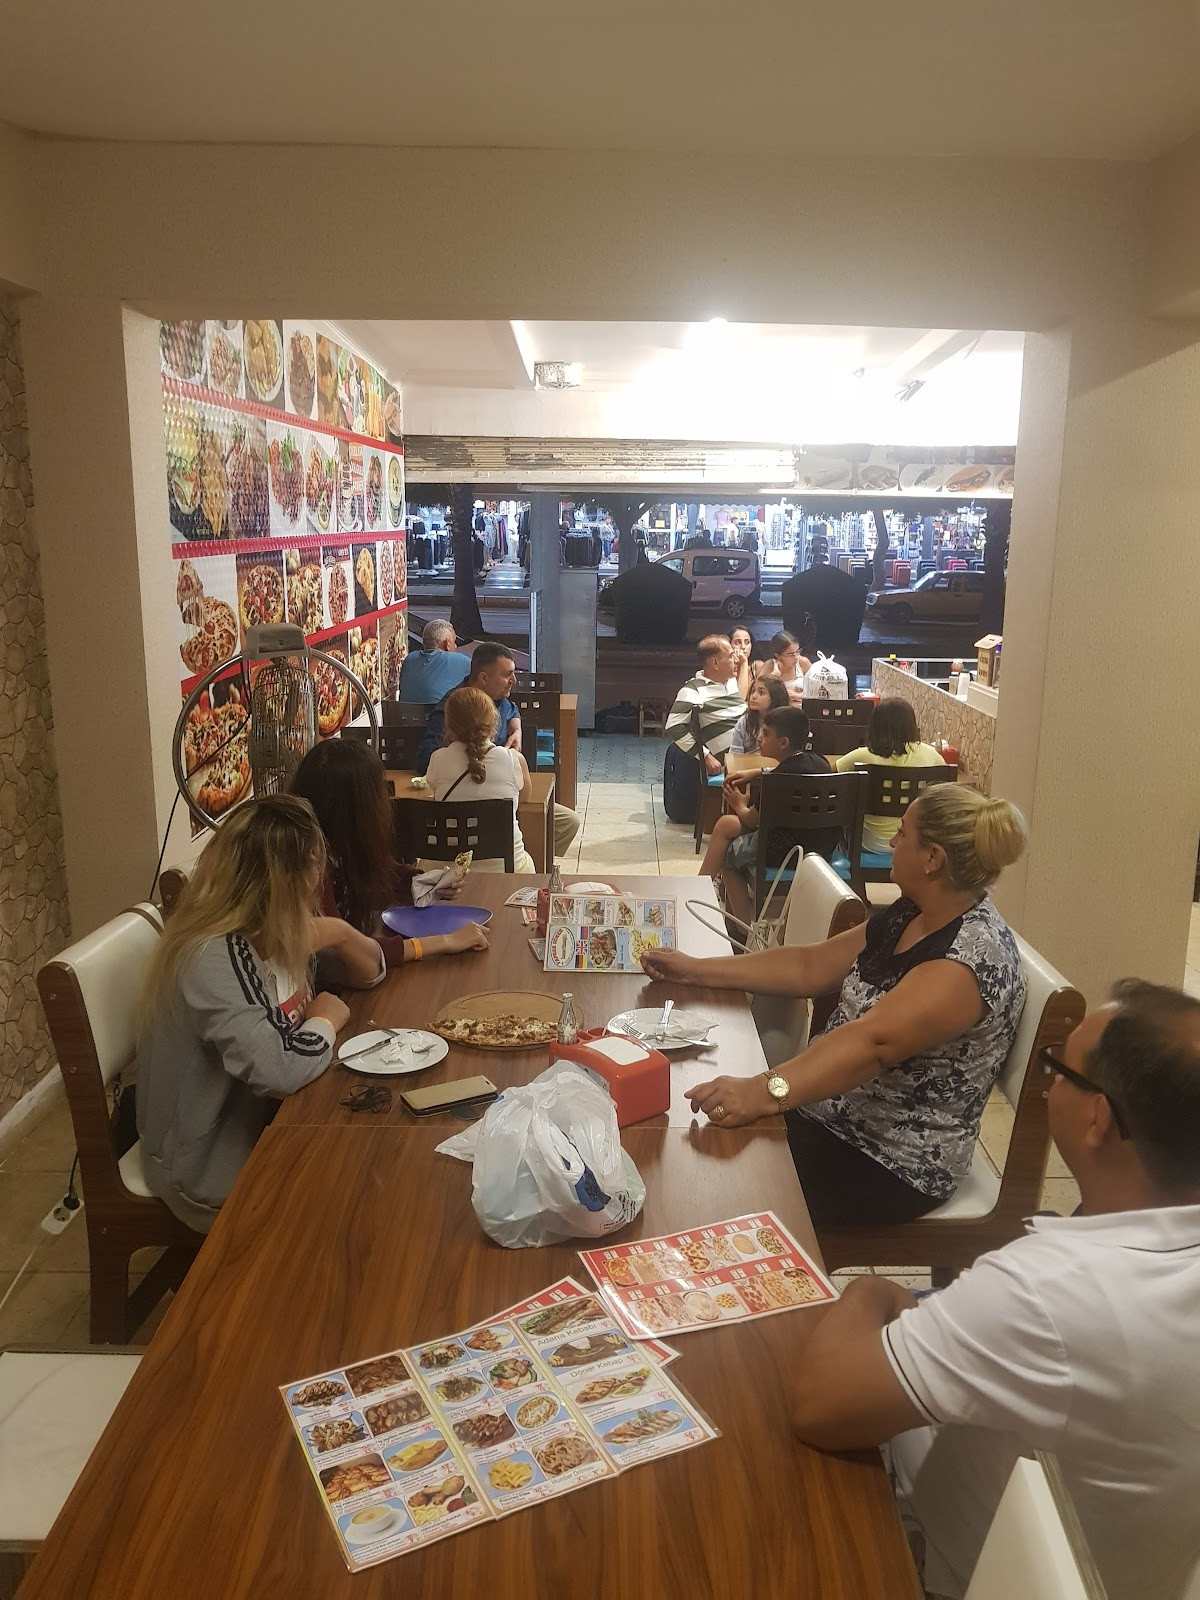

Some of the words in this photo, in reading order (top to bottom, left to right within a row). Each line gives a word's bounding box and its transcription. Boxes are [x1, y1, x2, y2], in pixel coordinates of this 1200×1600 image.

[537, 1333, 565, 1346] Adana
[570, 1365, 596, 1378] Döner
[596, 1357, 624, 1370] Kebap
